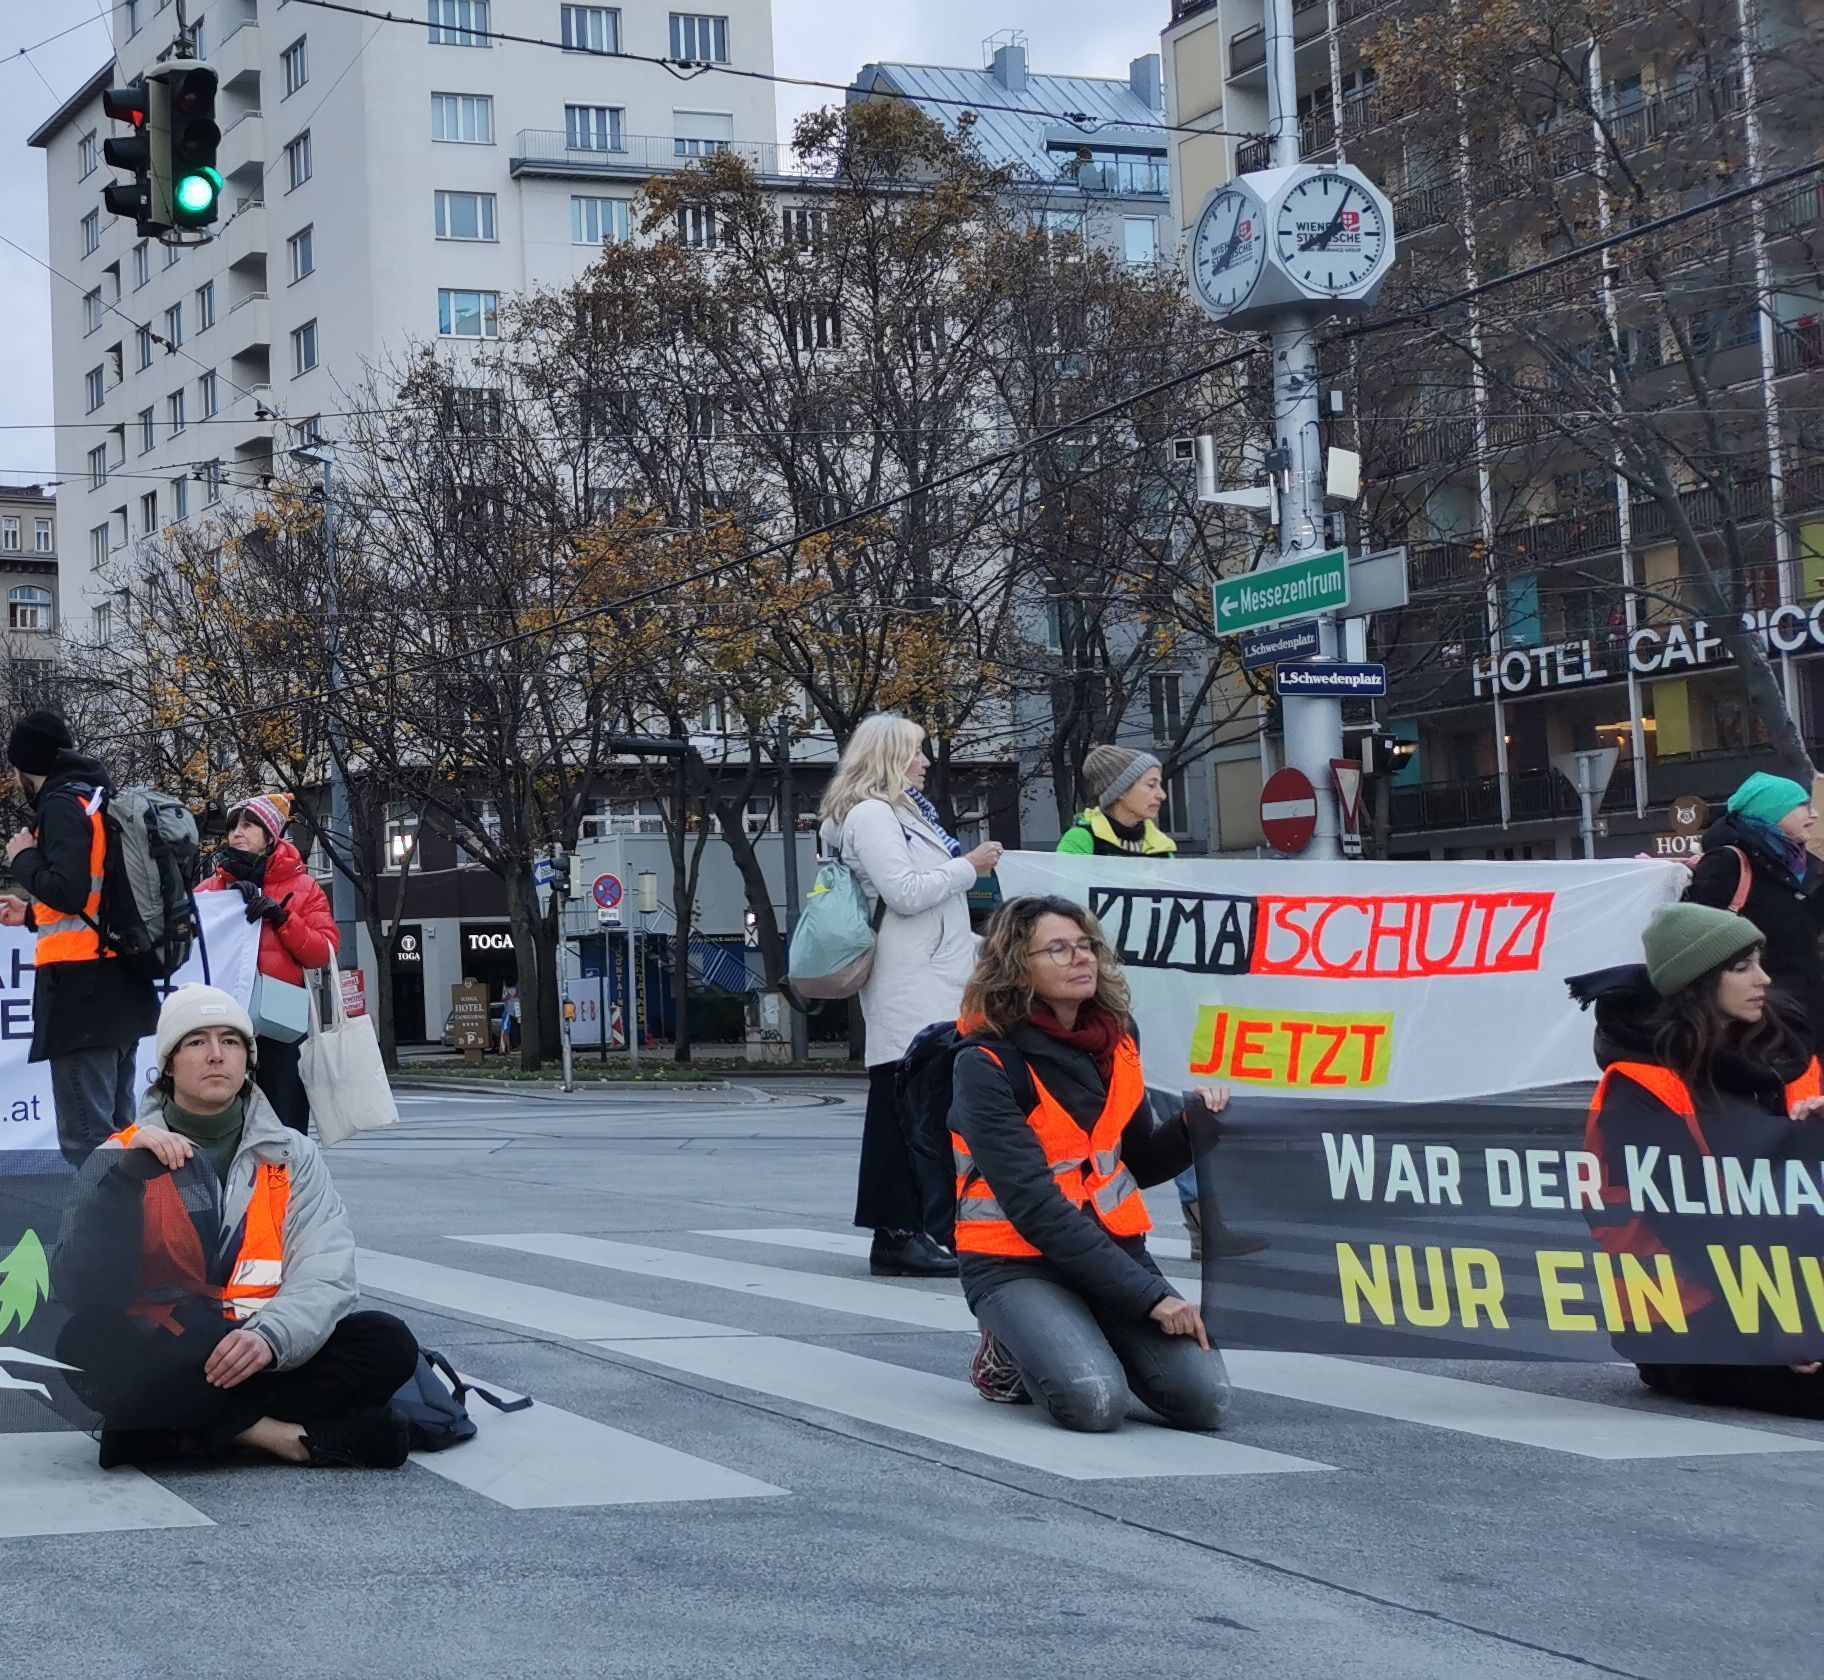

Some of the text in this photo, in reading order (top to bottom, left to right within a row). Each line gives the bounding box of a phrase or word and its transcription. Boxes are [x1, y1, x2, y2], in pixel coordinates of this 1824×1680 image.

[1240, 570, 1342, 615] Messezentrum
[1473, 638, 1608, 696] HOTEL
[1656, 834, 1704, 854] HOT
[397, 952, 421, 961] TOGA
[469, 934, 515, 949] TOGA
[455, 1003, 485, 1012] HOTEL
[1190, 1013, 1385, 1084] JETZT
[1322, 1133, 1824, 1216] WAR DER KLIMA
[1336, 1242, 1510, 1329] NUR
[1535, 1250, 1689, 1333] EIN
